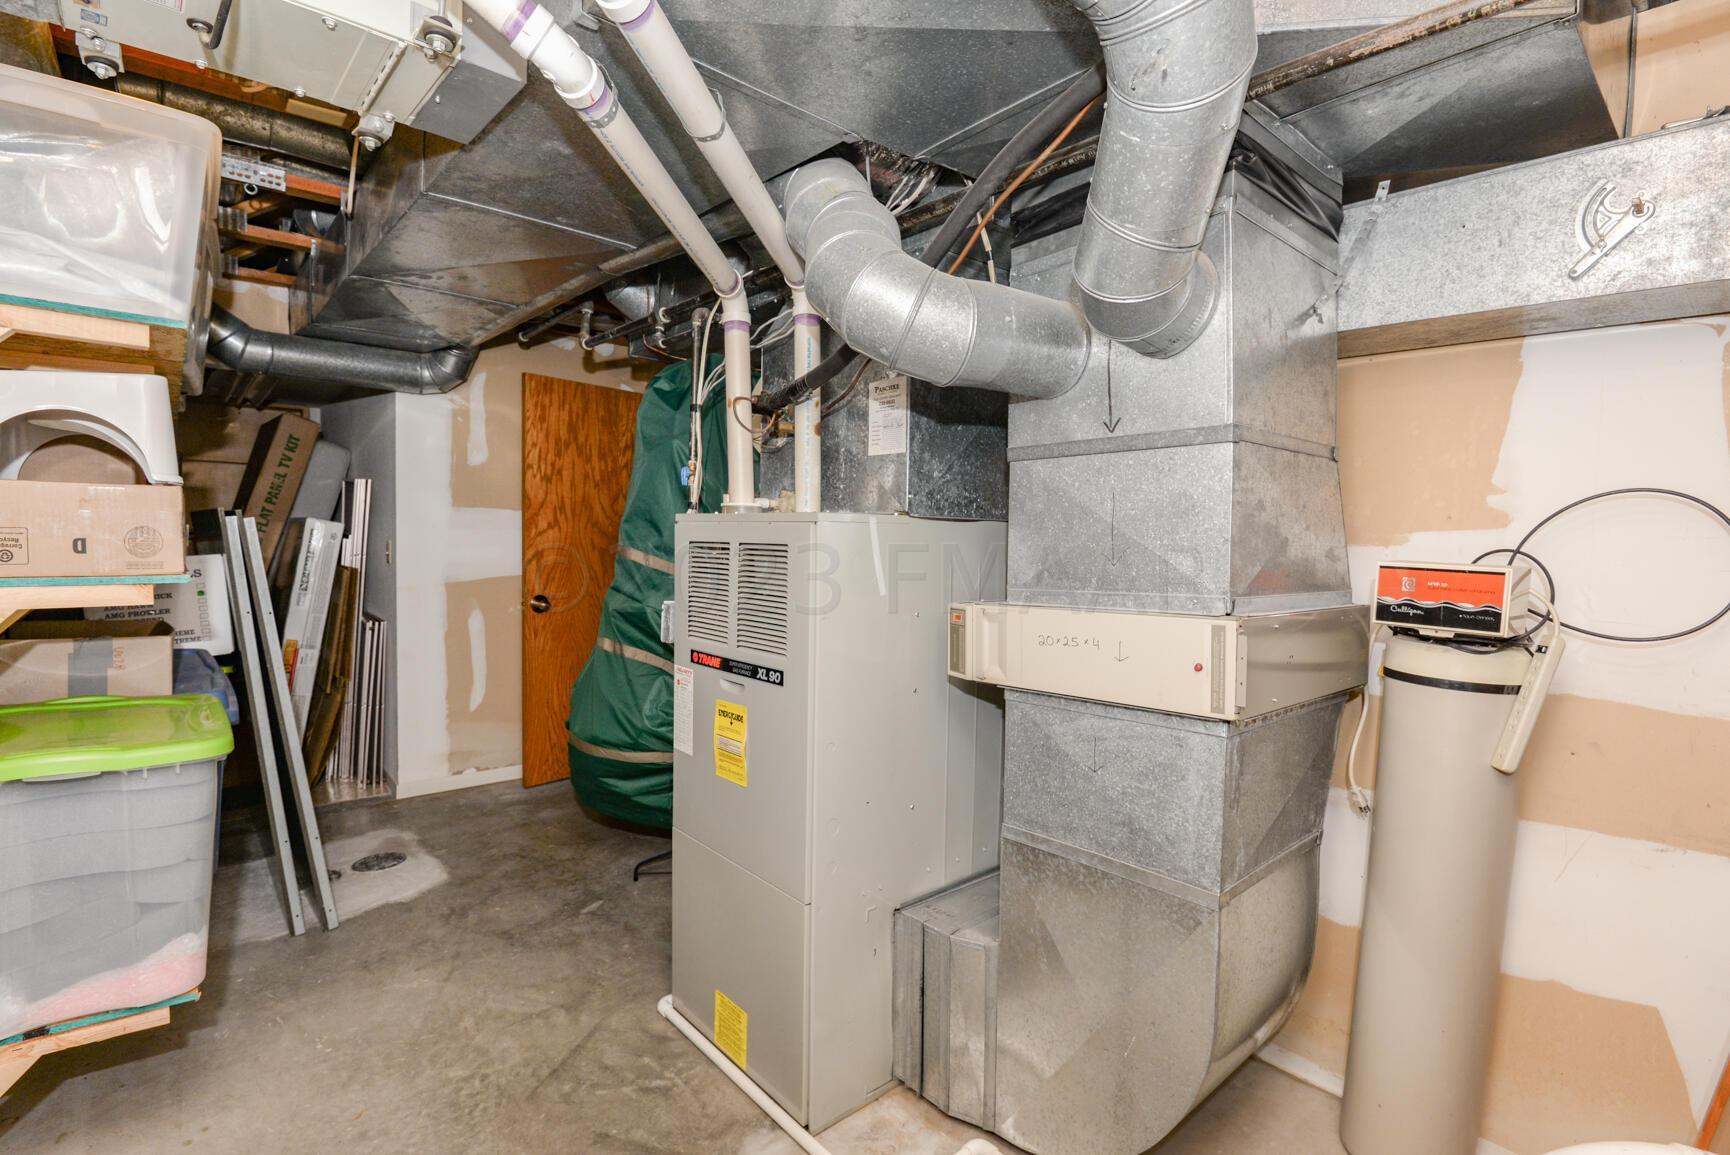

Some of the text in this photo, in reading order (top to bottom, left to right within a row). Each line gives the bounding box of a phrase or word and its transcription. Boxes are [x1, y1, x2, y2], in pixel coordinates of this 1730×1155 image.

[256, 433, 300, 533] FLAT PANEL TV KIT
[72, 537, 87, 554] D
[699, 653, 721, 669] TRANE
[756, 667, 781, 684] XL 90
